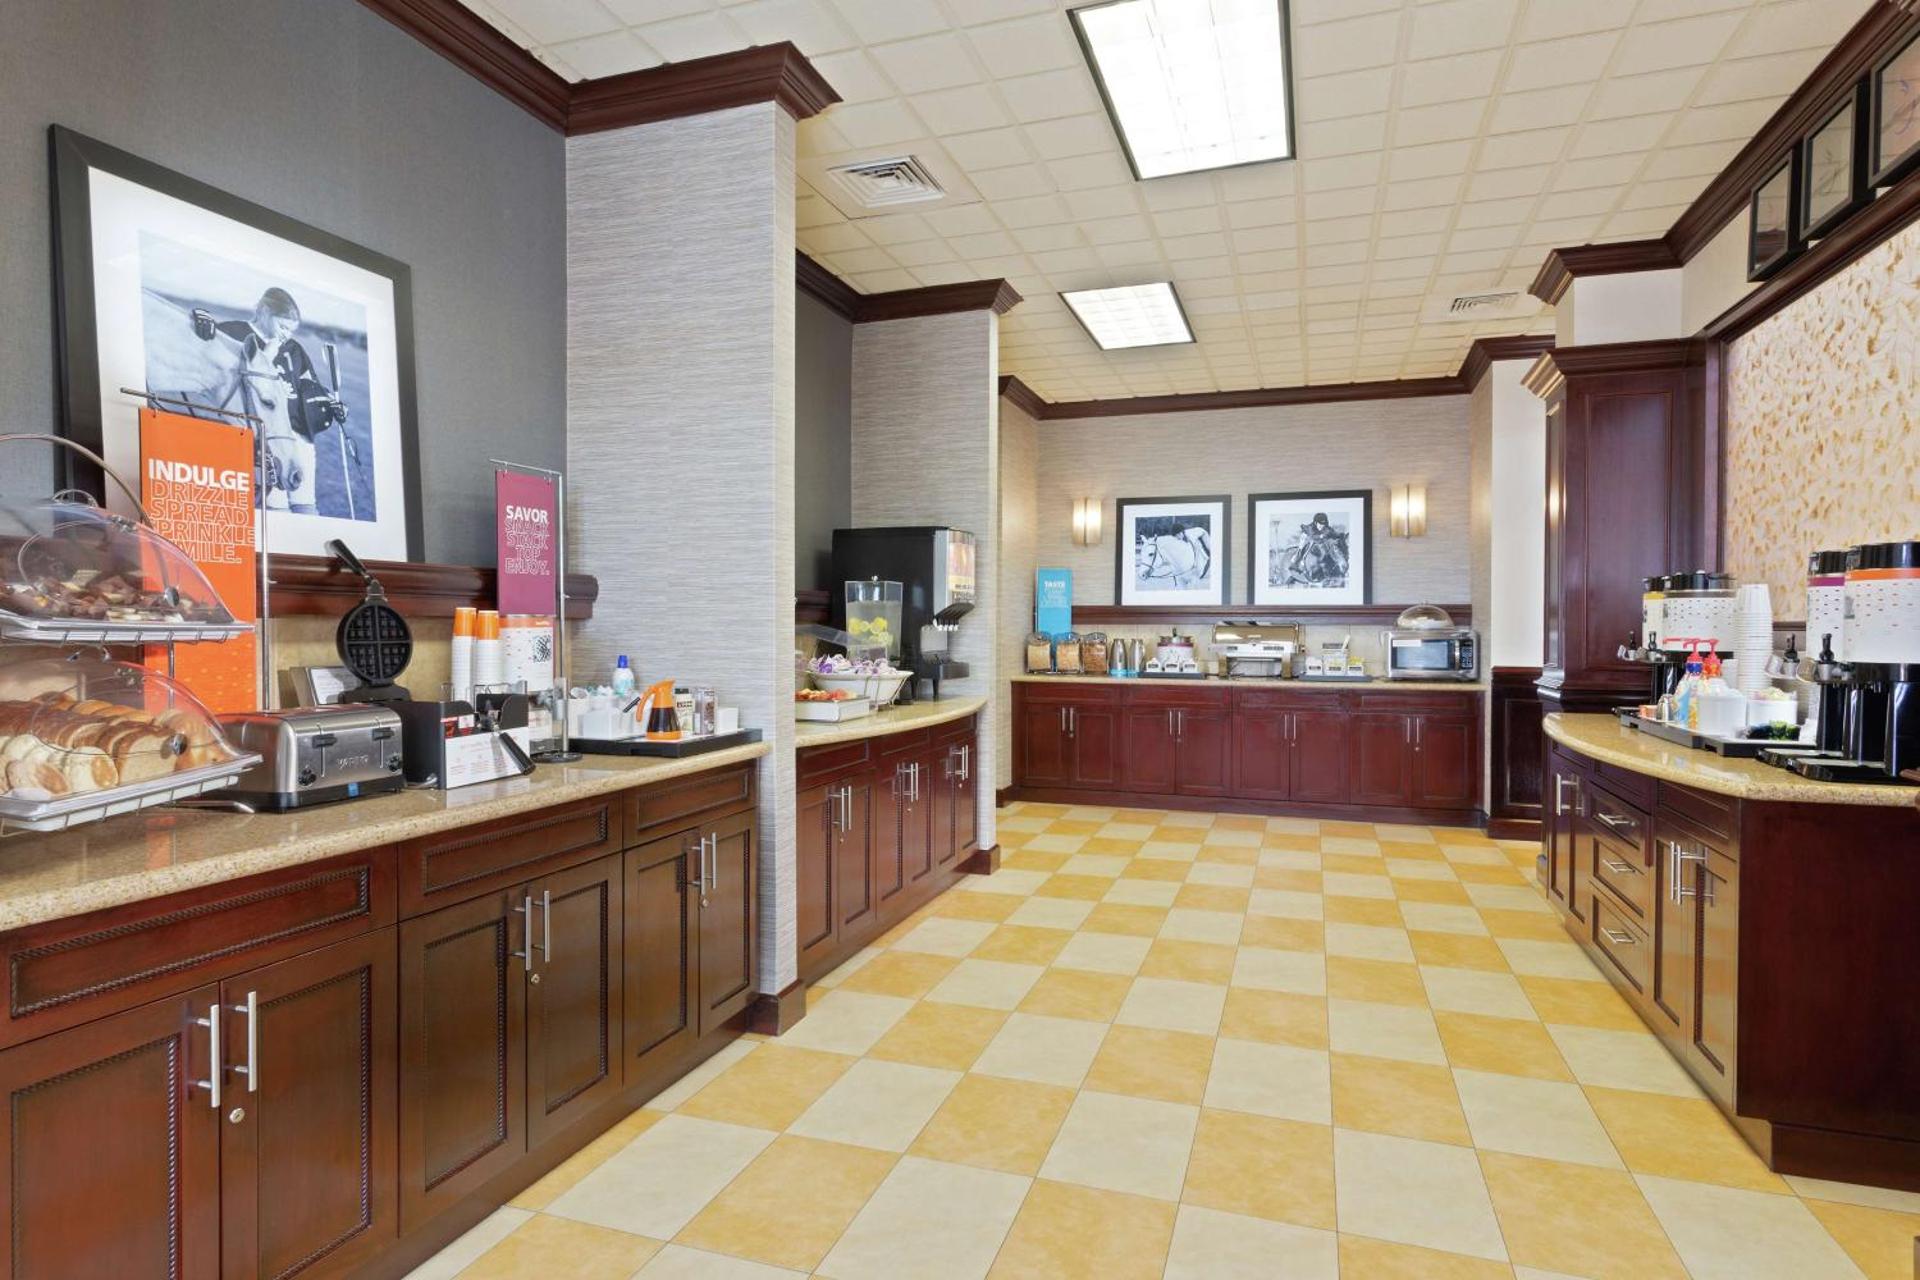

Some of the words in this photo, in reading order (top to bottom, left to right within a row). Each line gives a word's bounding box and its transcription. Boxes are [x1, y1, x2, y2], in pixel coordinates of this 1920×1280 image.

[148, 458, 250, 492] INDULGE
[151, 479, 249, 510] DRIZZLE
[150, 499, 249, 526] SPREAD
[506, 505, 548, 524] SAVOR
[152, 517, 255, 547] PRINKLE
[176, 540, 242, 564] MILE.
